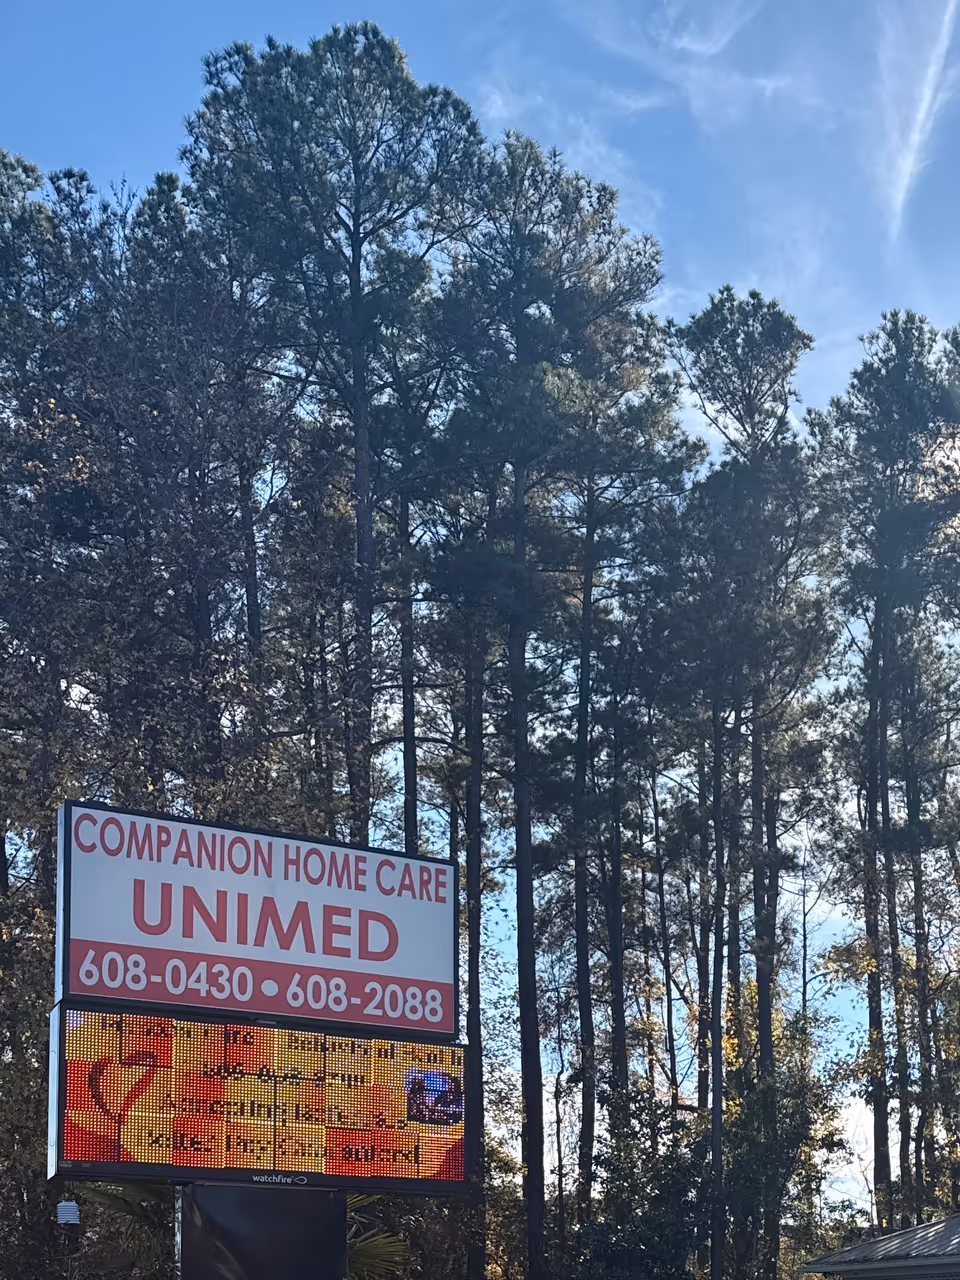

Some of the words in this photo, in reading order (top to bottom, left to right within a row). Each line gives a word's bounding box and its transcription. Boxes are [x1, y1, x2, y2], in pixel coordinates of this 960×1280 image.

[74, 813, 272, 878] COMPANION
[284, 844, 367, 892] HOME
[376, 859, 447, 904] CARE
[133, 879, 399, 962] UNIMED
[79, 949, 254, 1002] 608-0430
[286, 973, 444, 1023] 608-2088
[252, 1174, 293, 1185] watchfire
